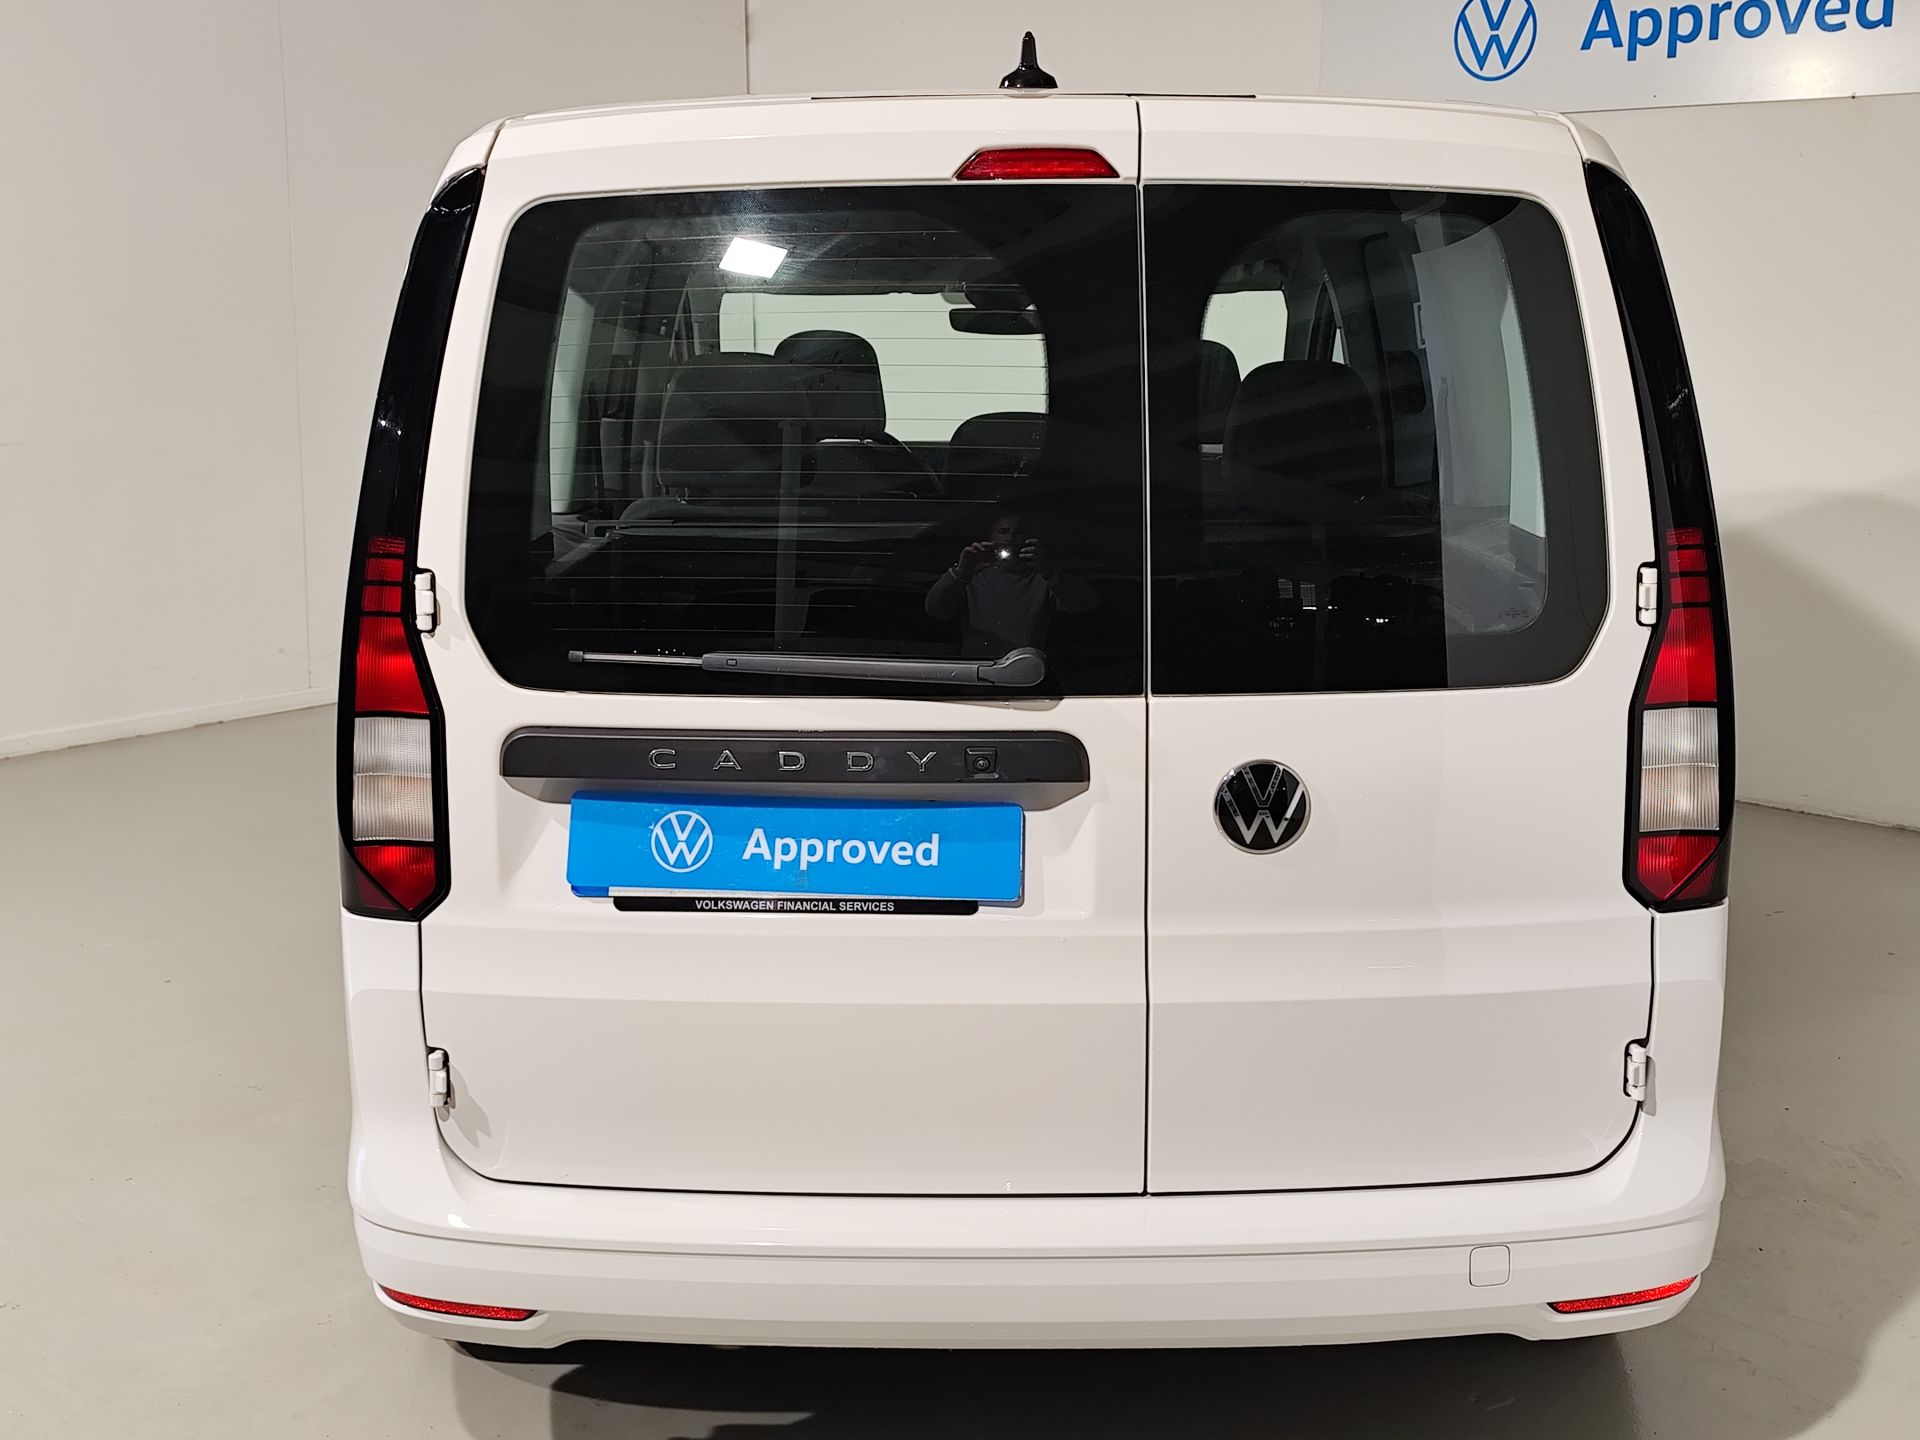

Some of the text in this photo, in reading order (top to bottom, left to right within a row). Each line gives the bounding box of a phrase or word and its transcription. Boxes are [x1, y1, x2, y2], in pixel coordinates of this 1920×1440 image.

[649, 748, 936, 772] CADDY
[742, 827, 940, 871] Approved
[695, 899, 895, 912] VOLKSWAGEN FINANCIAL SERVICES
